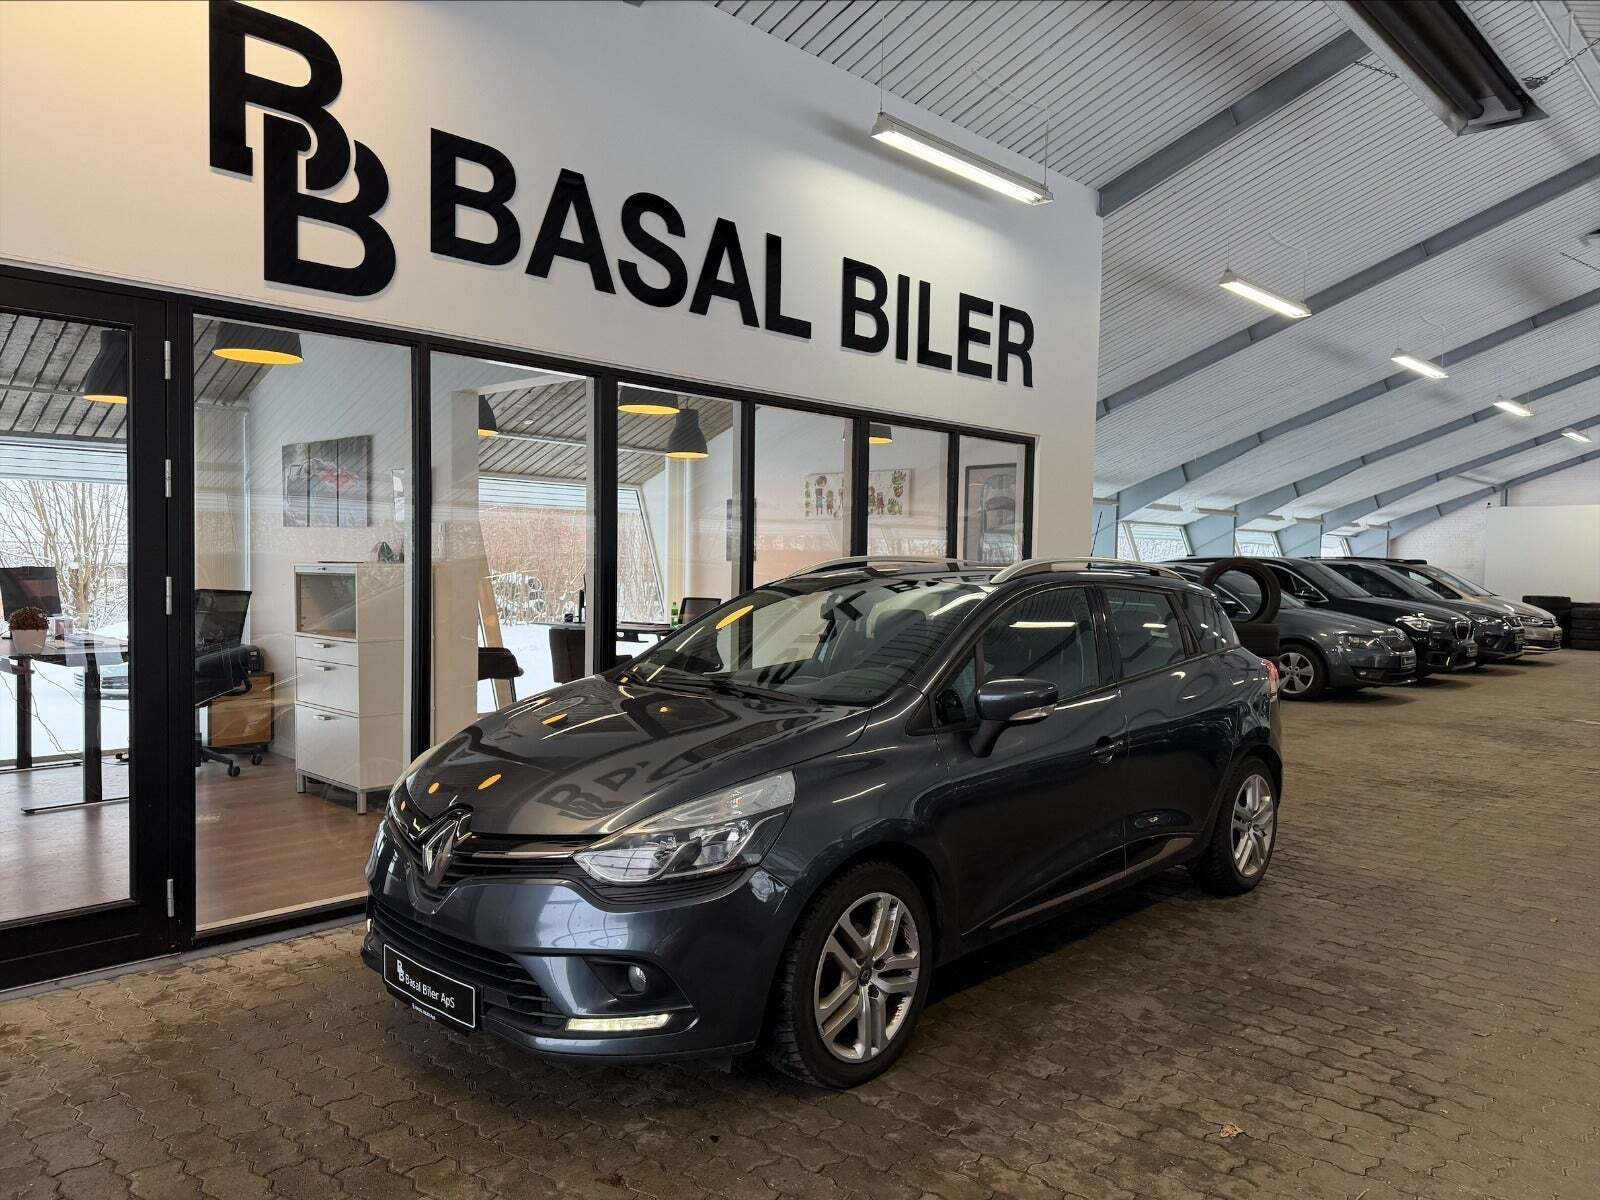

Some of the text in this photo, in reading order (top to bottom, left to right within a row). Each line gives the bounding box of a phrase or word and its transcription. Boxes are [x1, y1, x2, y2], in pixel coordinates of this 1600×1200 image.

[431, 128, 1034, 388] BASAL BILER
[405, 974, 421, 992] Basal
[422, 984, 439, 1000] Biler
[441, 993, 455, 1008] ApS
